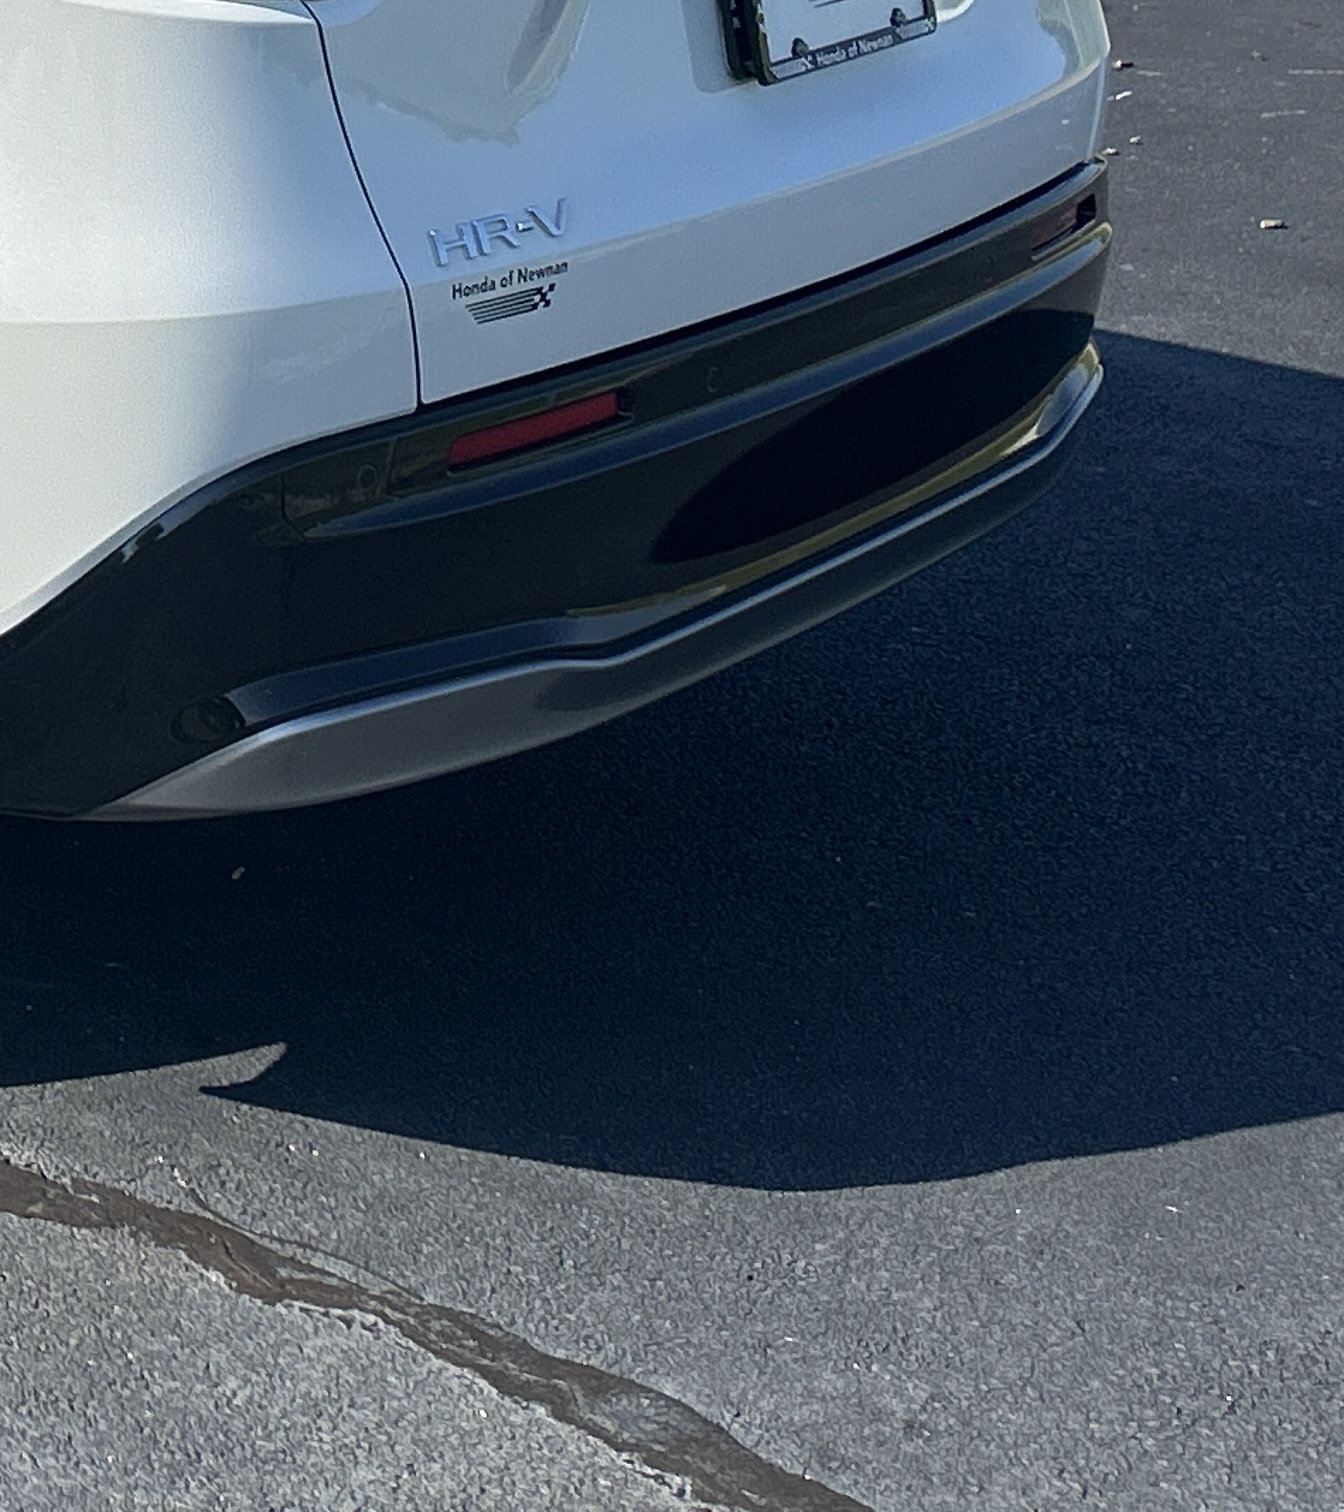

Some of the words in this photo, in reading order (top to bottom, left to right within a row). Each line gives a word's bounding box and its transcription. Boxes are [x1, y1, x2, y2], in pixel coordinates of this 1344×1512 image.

[427, 197, 567, 268] HR-V
[451, 275, 496, 300] Honda
[500, 270, 514, 288] of
